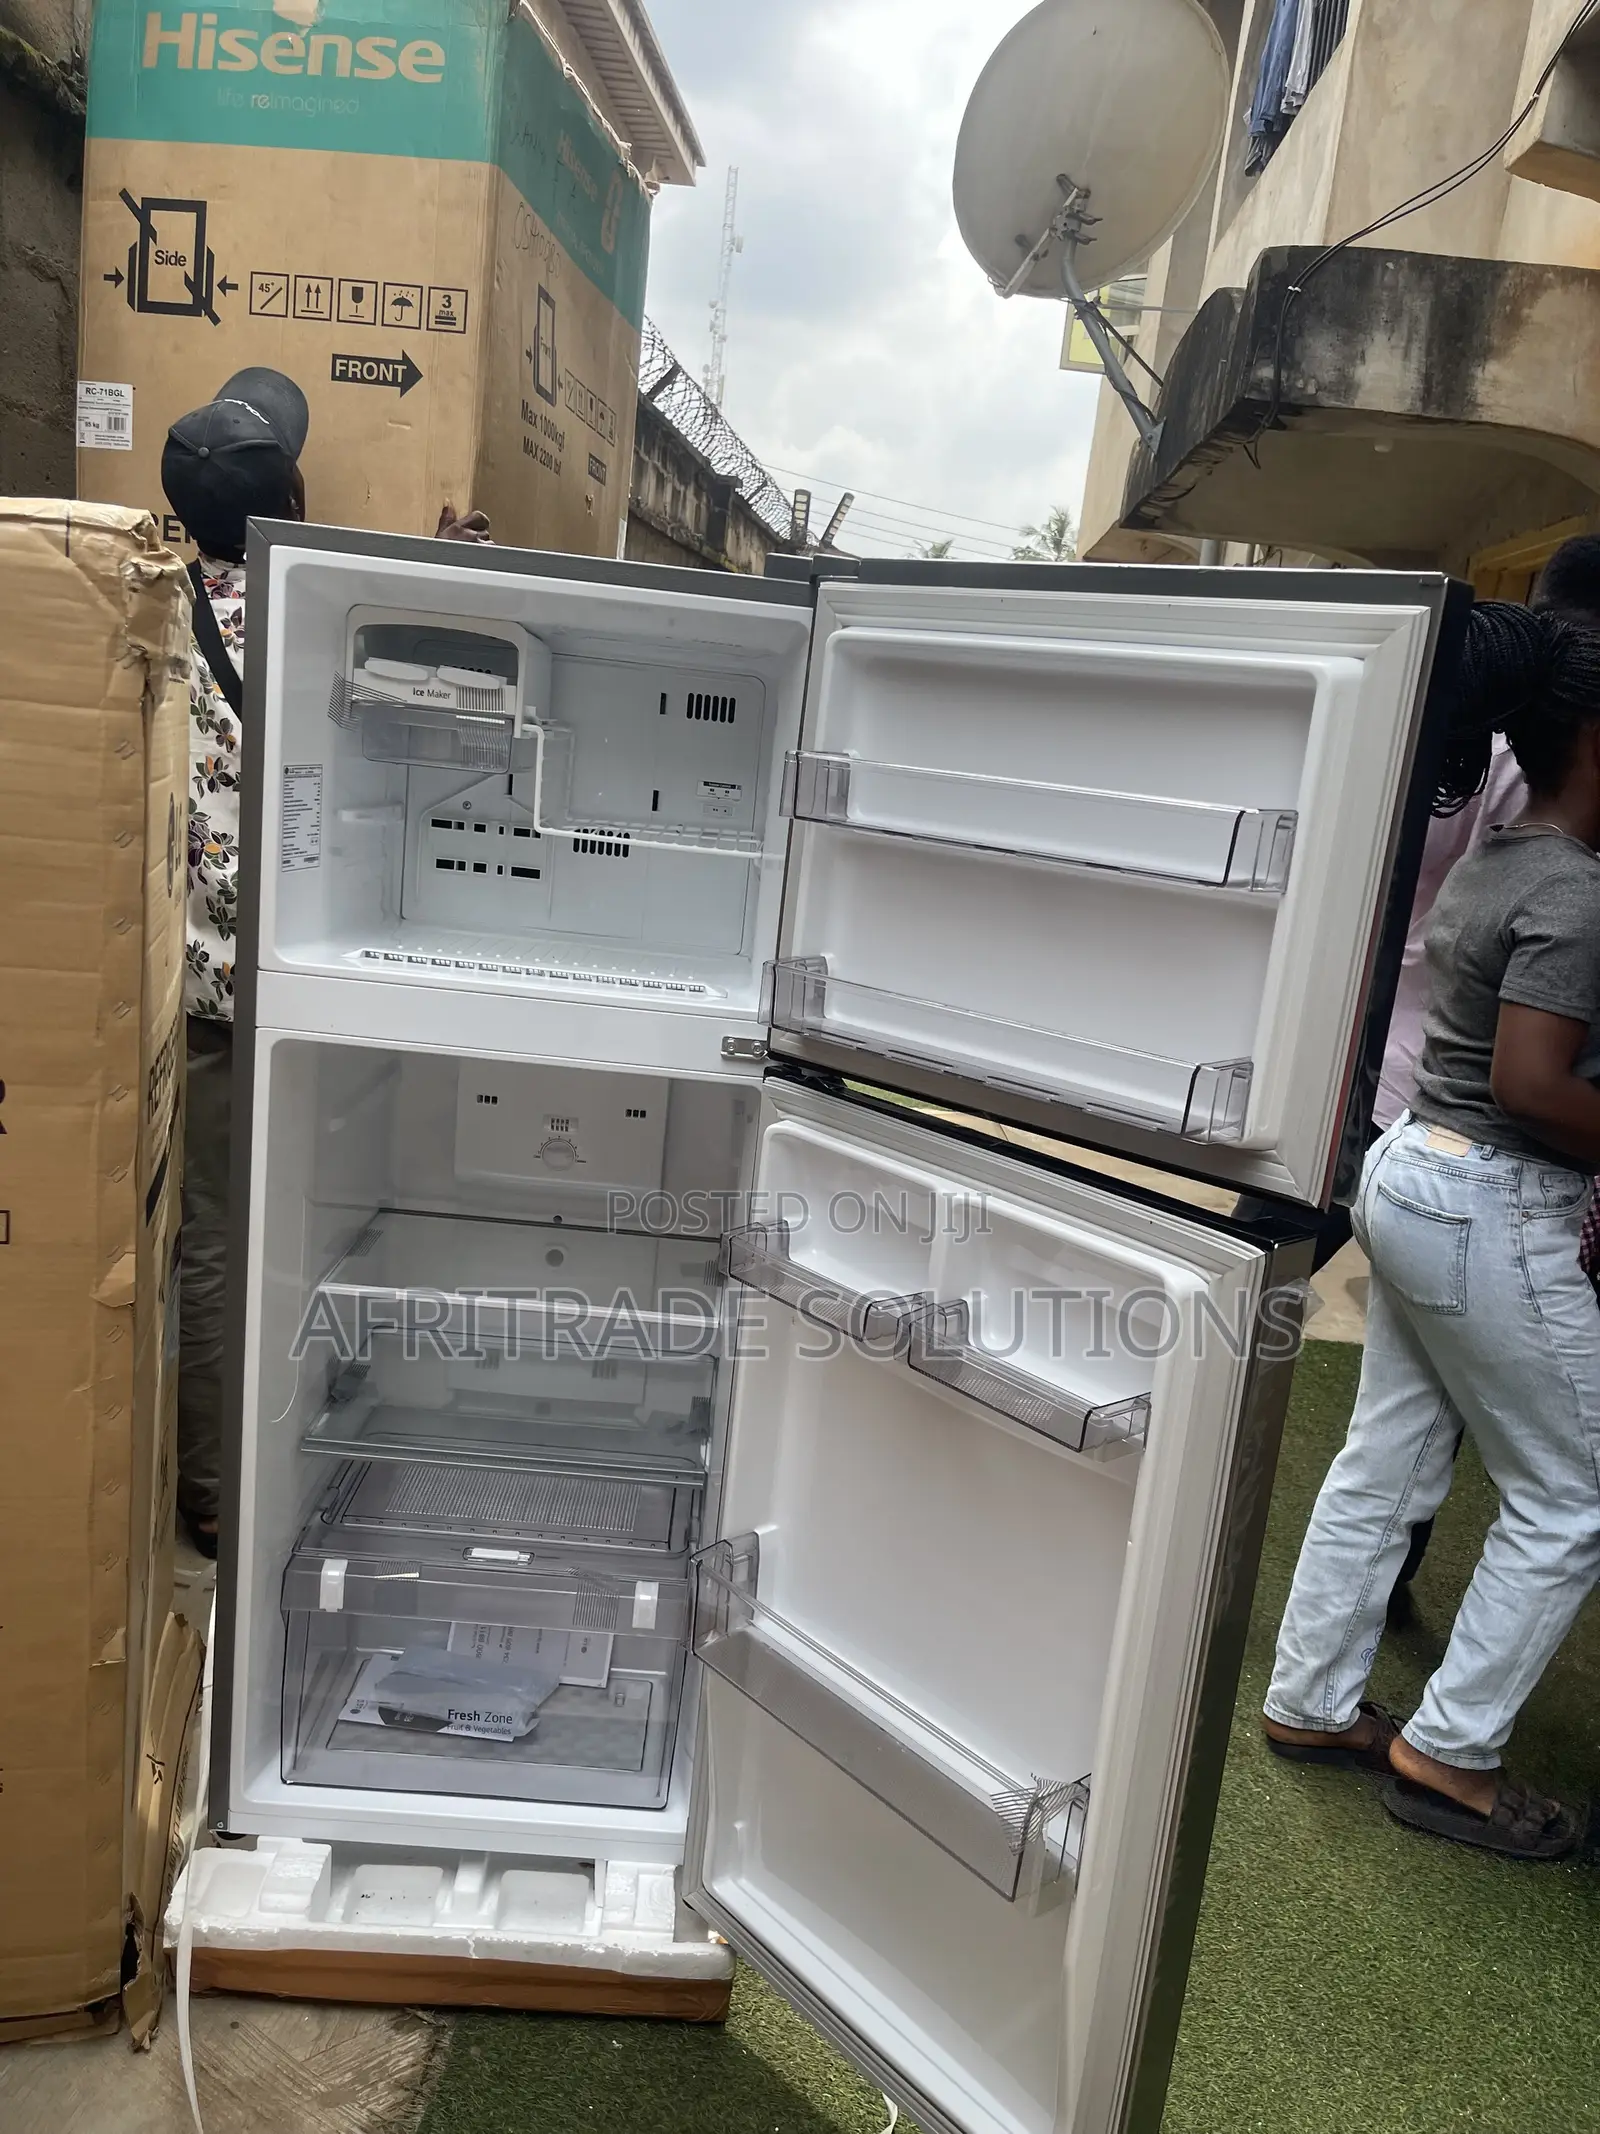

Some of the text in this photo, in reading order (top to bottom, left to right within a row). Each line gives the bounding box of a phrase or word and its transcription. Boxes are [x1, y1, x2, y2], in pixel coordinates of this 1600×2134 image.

[142, 11, 446, 83] Hisense
[217, 87, 360, 118] life reimagined
[154, 249, 187, 267] Side
[441, 294, 453, 308] 3
[438, 308, 455, 317] max
[335, 359, 407, 383] FRONT
[85, 387, 125, 398] RC-71BGL
[521, 399, 538, 429] Max
[522, 435, 539, 463] MAX
[412, 686, 452, 700] Ice Maker
[447, 1709, 513, 1725] Fresh Zone
[473, 1725, 512, 1735] Vegetables
